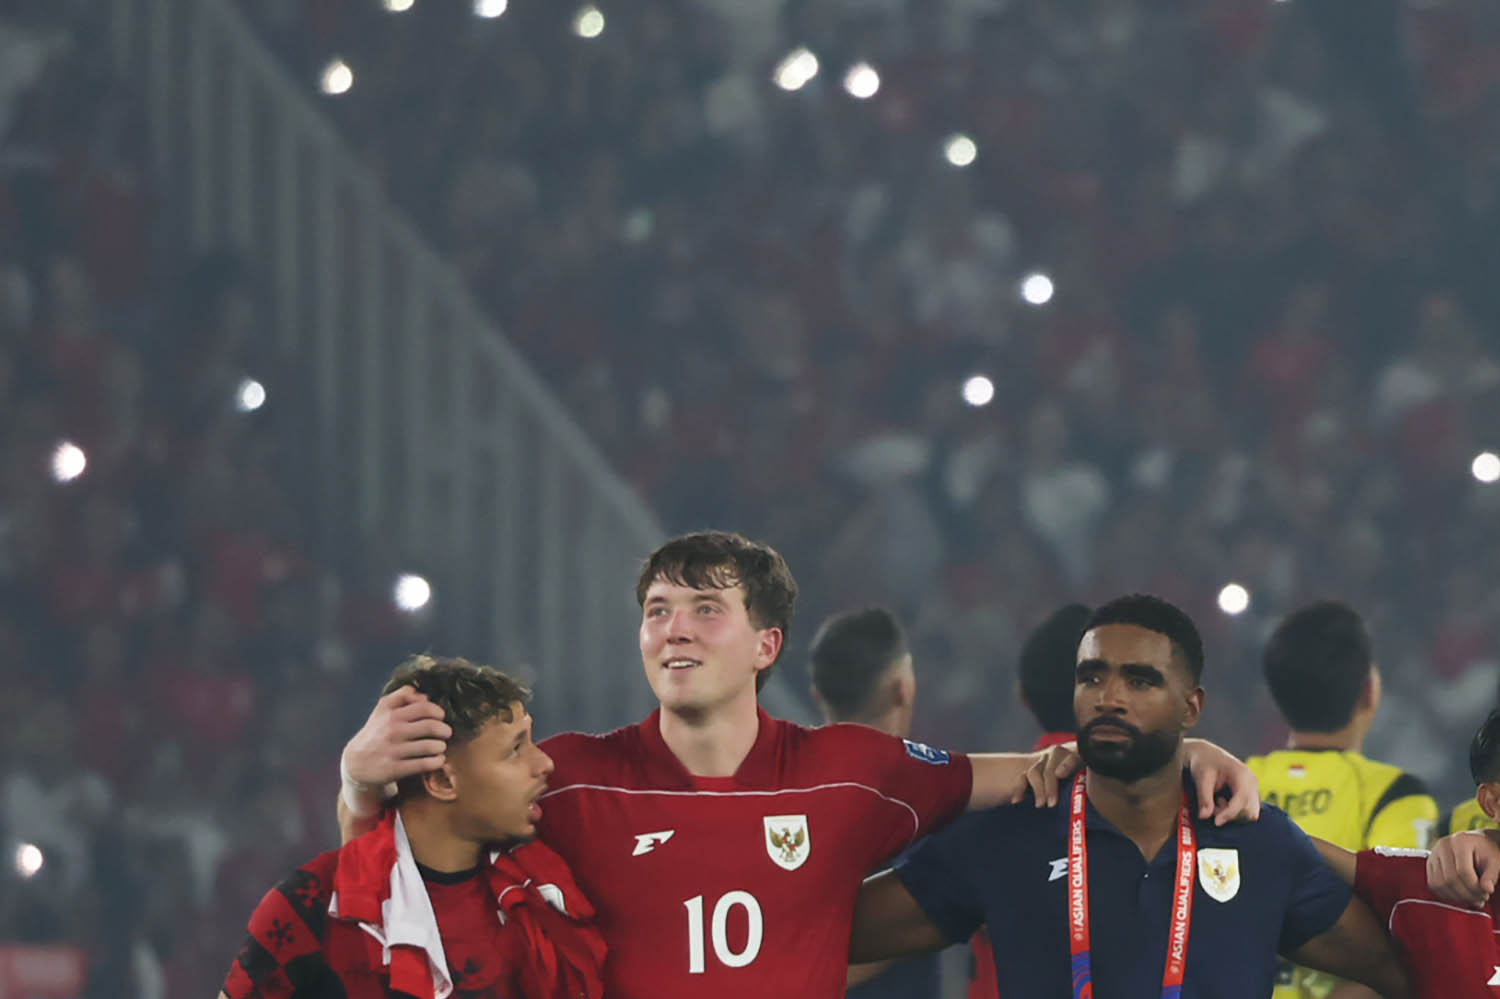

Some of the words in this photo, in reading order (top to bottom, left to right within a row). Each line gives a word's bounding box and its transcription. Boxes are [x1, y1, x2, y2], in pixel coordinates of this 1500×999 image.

[1071, 819, 1085, 887] QUALIFIERS
[1177, 851, 1193, 921] QUALIFIERS
[683, 890, 763, 973] 10
[1072, 889, 1085, 927] ASIAN
[1171, 921, 1187, 961] ASIAN
